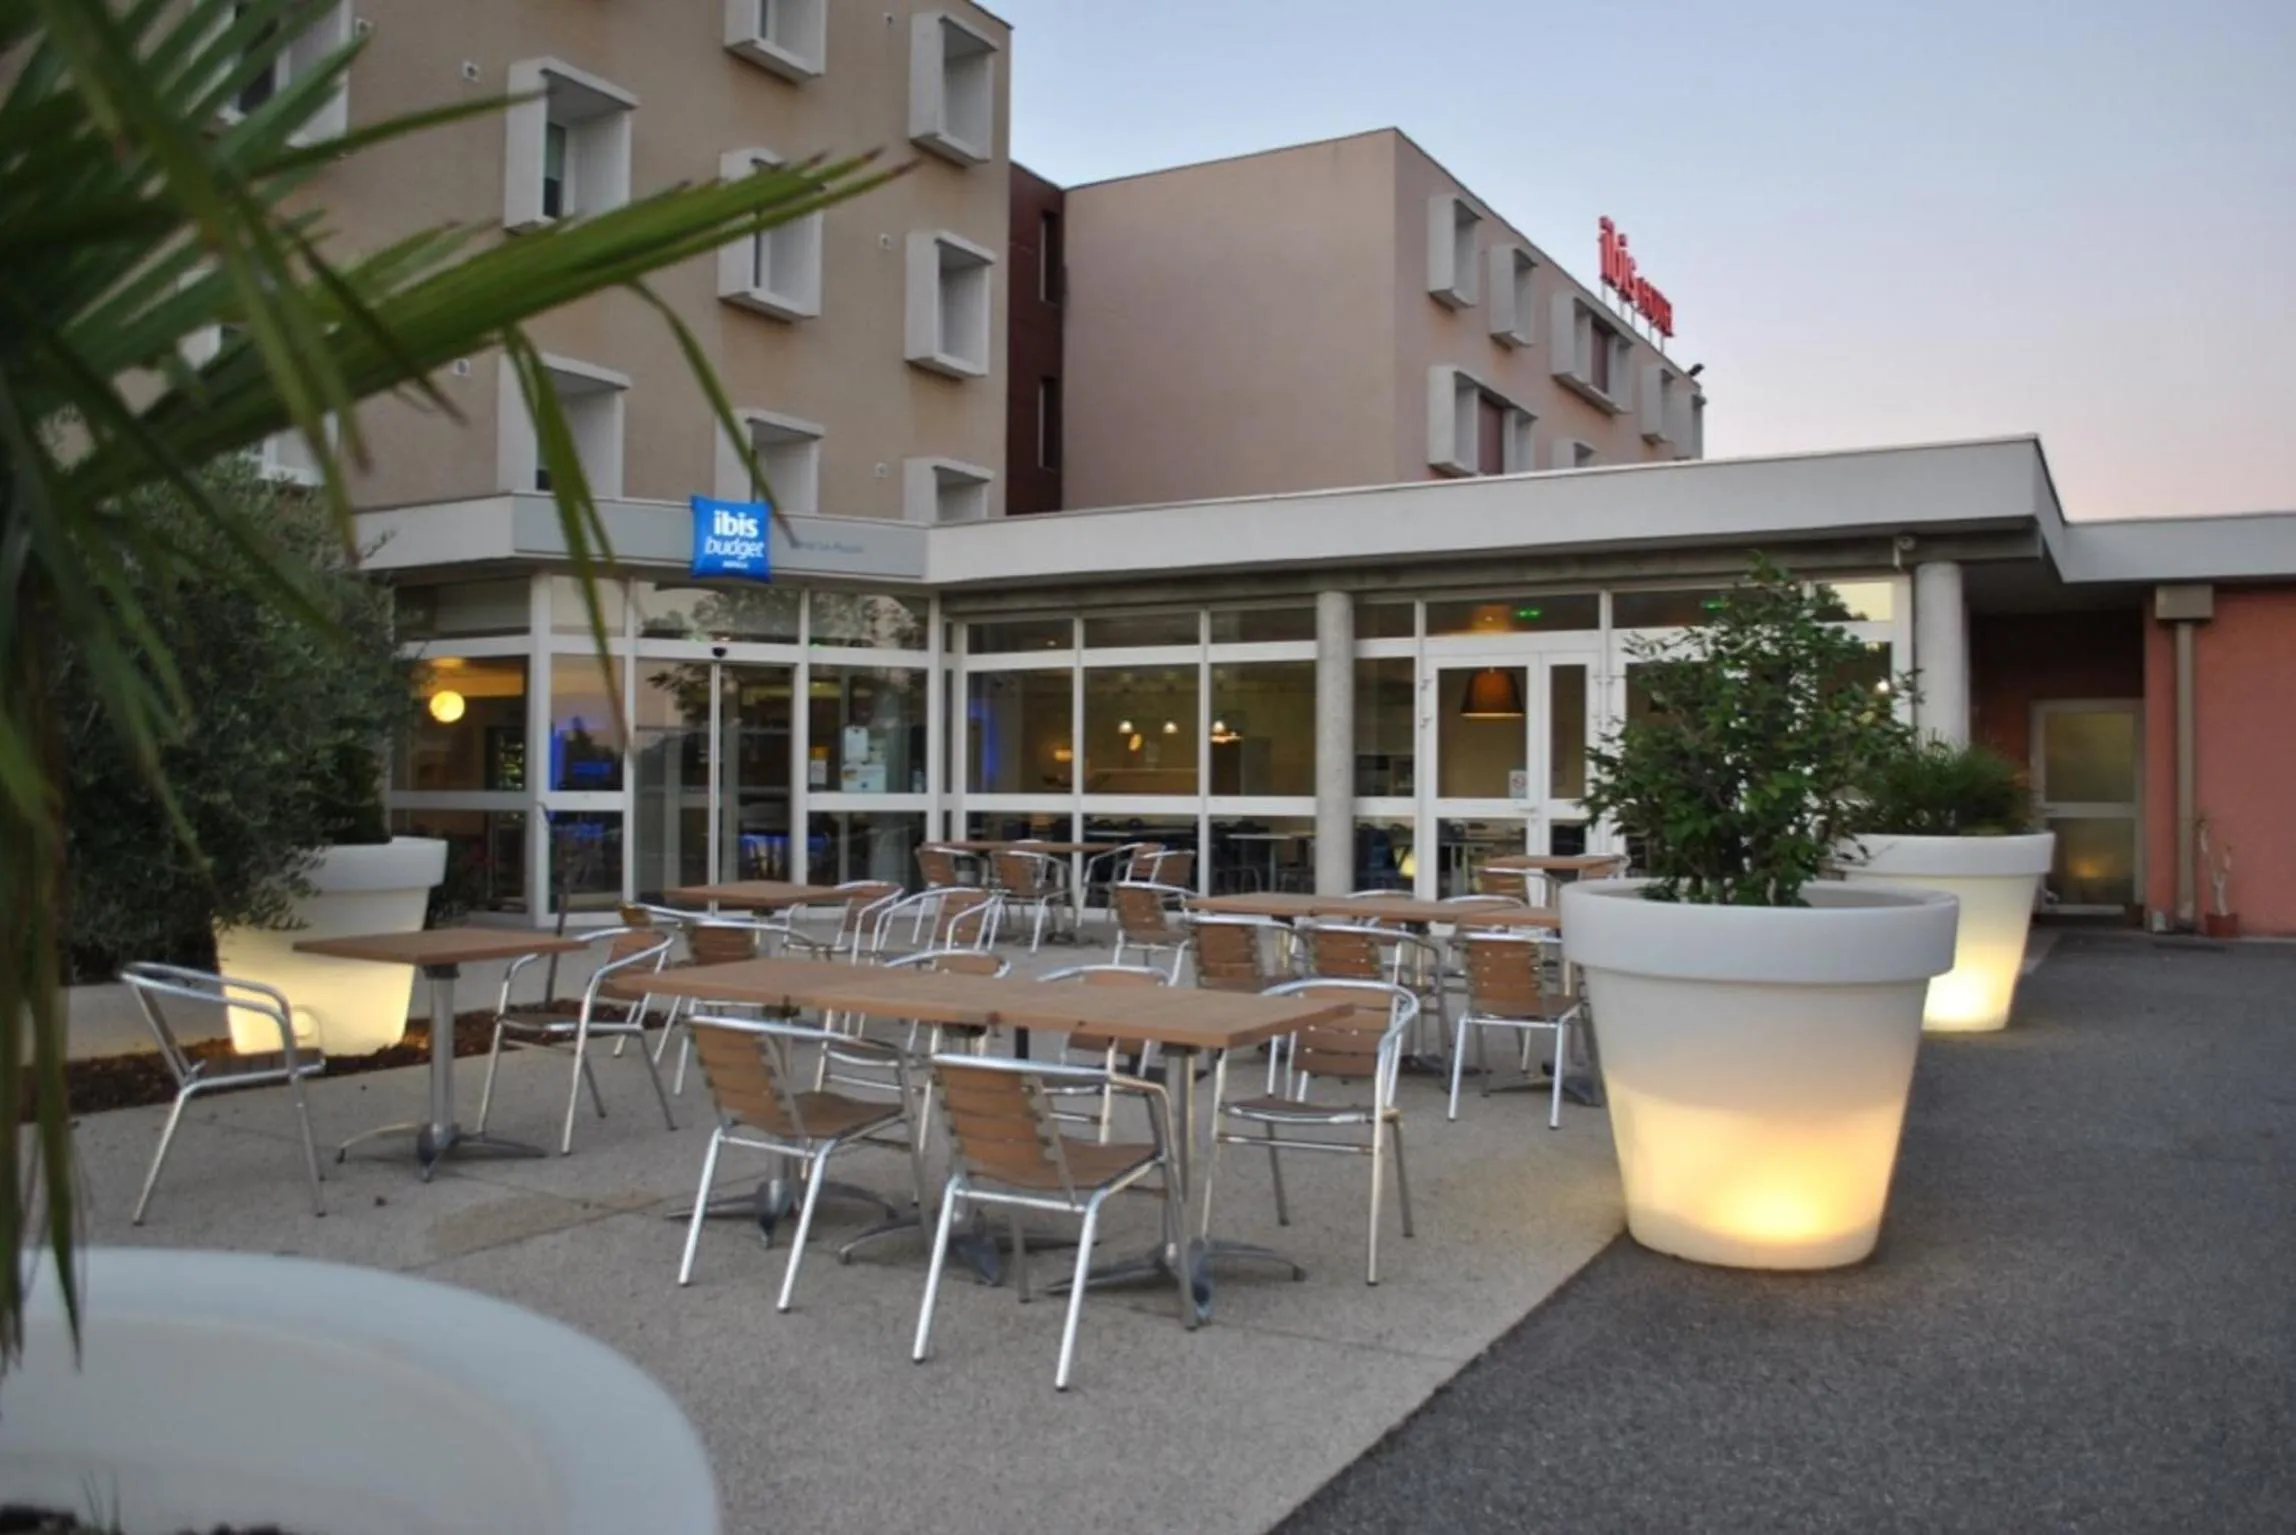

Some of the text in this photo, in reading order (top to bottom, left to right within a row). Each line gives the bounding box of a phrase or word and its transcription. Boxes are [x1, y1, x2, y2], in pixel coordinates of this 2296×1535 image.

[1599, 216, 1636, 302] ibis
[714, 510, 758, 538] ibis
[705, 536, 764, 560] budget
